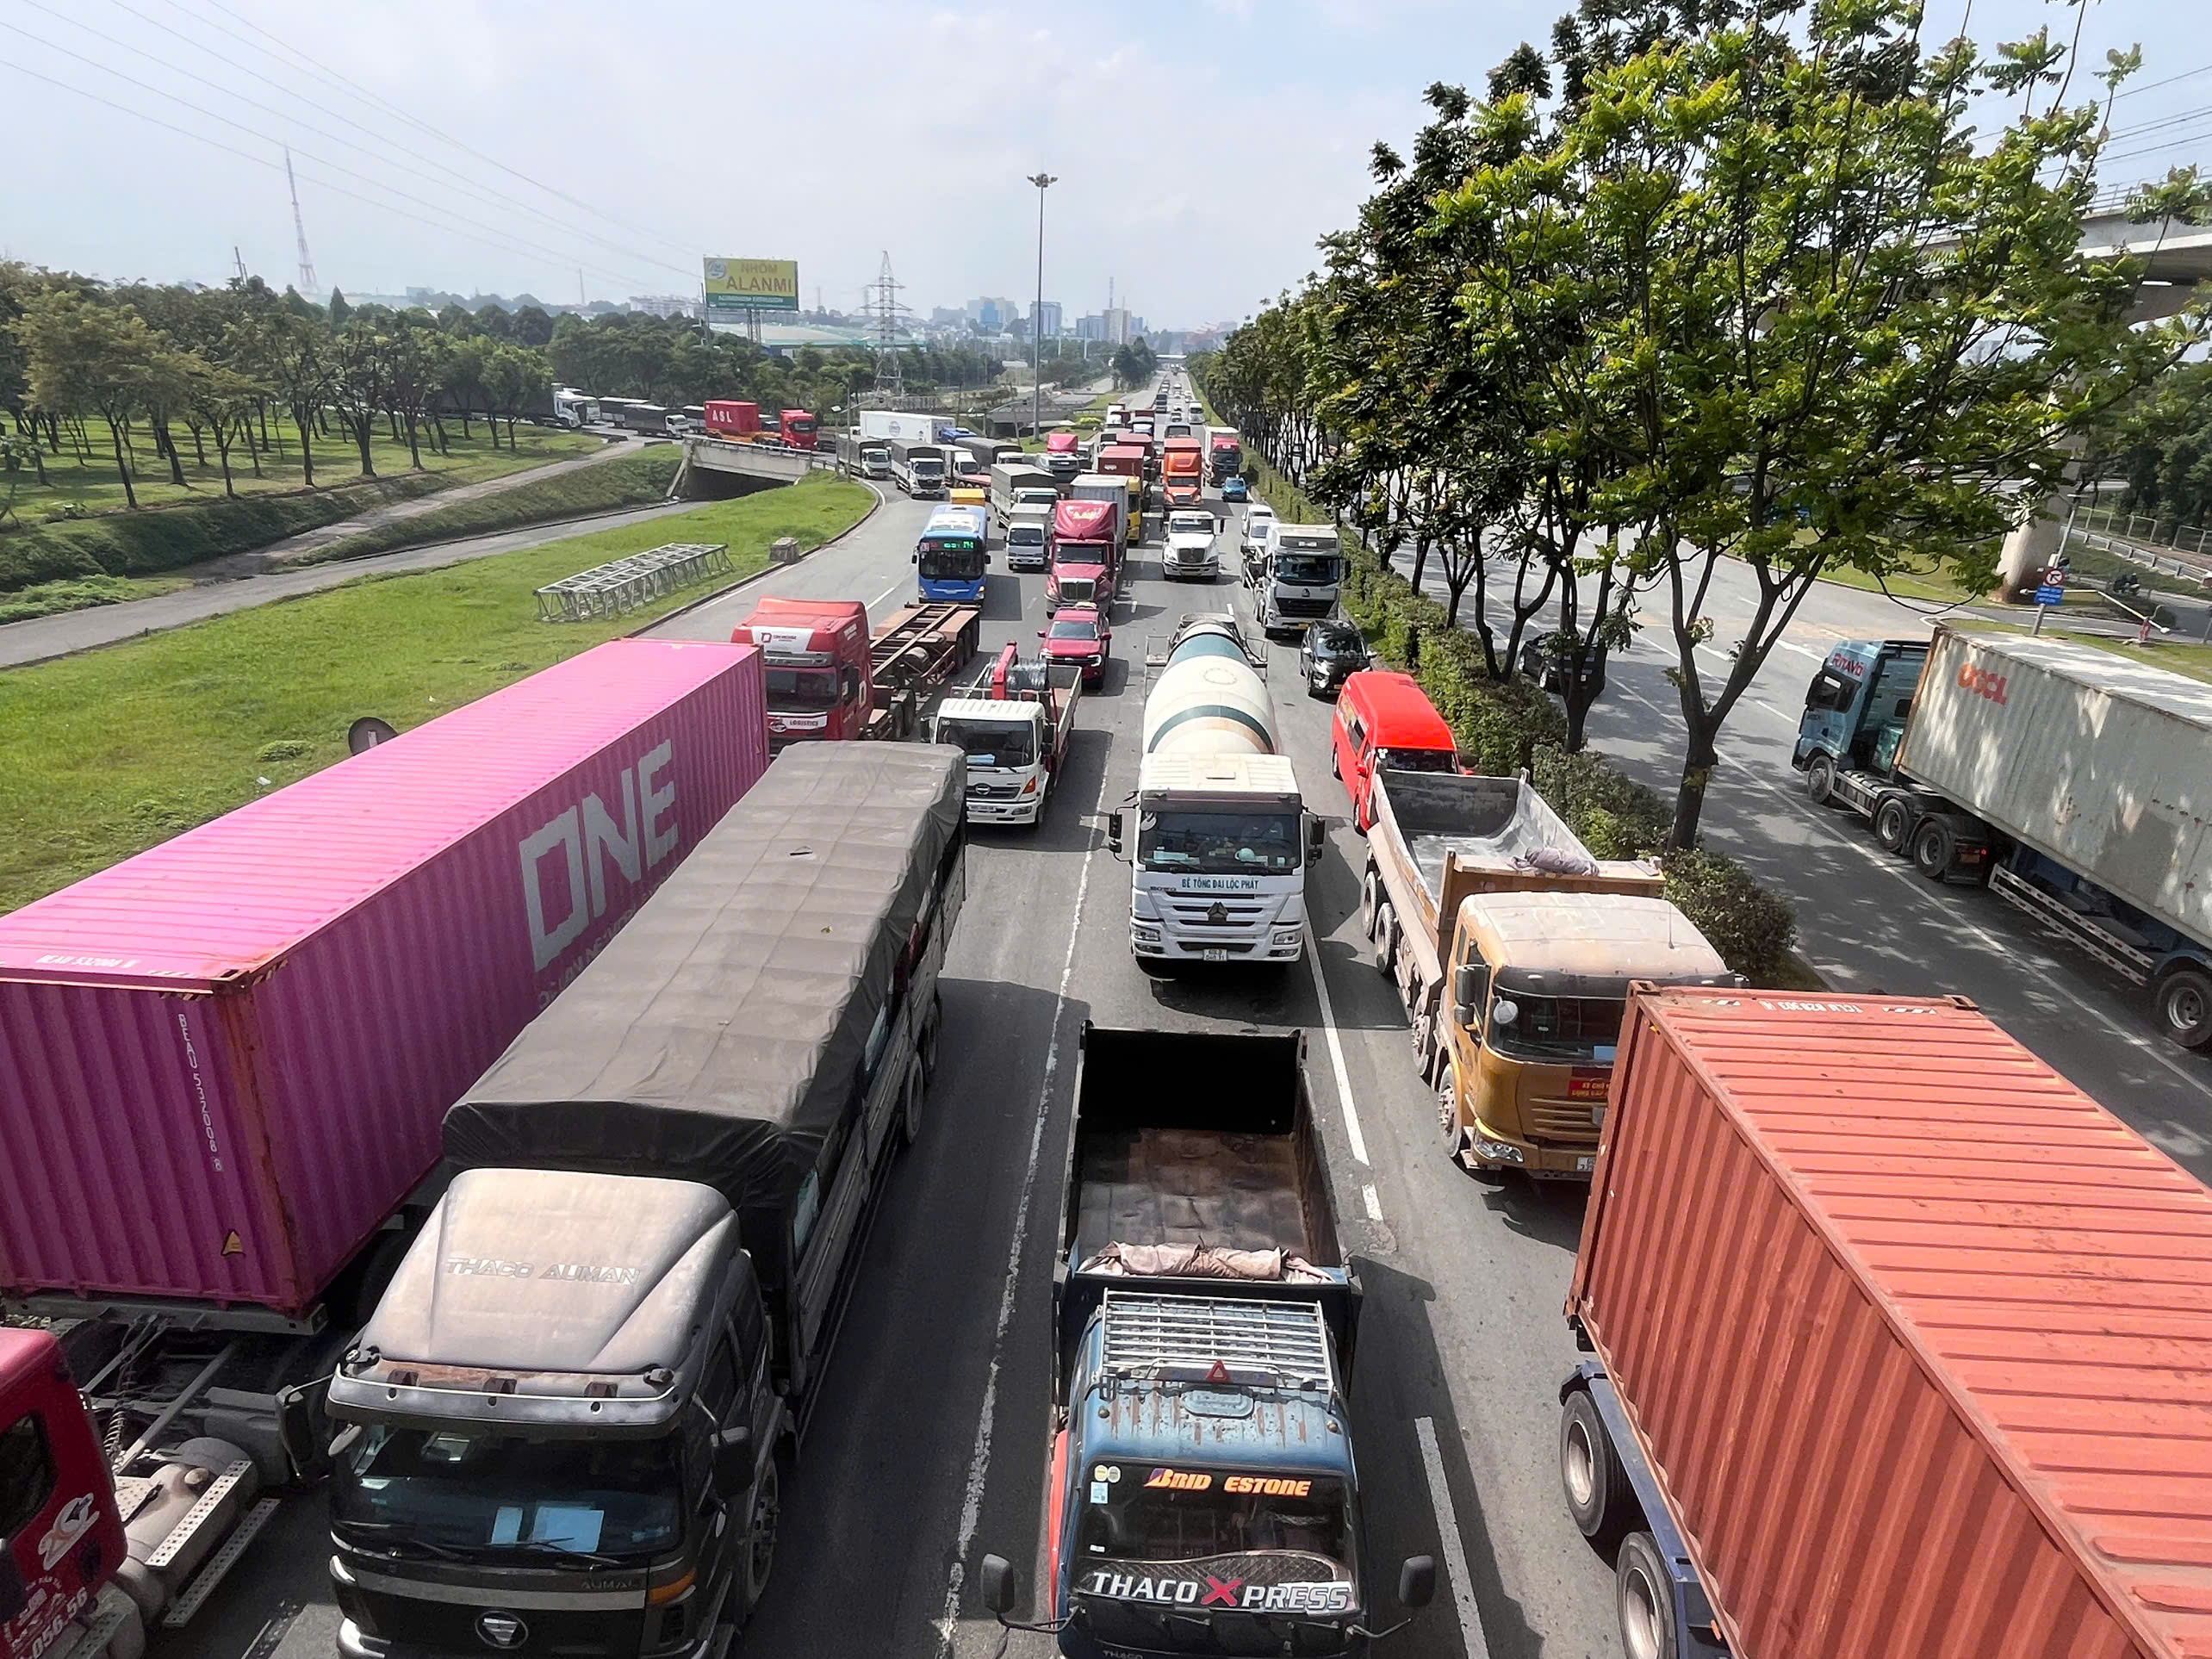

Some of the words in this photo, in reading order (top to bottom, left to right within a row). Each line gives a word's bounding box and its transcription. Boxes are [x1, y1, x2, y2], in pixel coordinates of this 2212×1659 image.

[726, 276, 792, 292] ALANMI
[712, 409, 732, 423] ASL
[1957, 662, 2008, 706] OOCL
[519, 737, 679, 972] ONE
[178, 1013, 198, 1069] BEAU
[193, 1072, 218, 1153] 532008
[214, 1158, 223, 1171] 8
[447, 1257, 535, 1278] THACO
[538, 1263, 640, 1284] AUMAN
[1144, 1467, 1212, 1491] BRID
[1223, 1476, 1312, 1497] ESTONE
